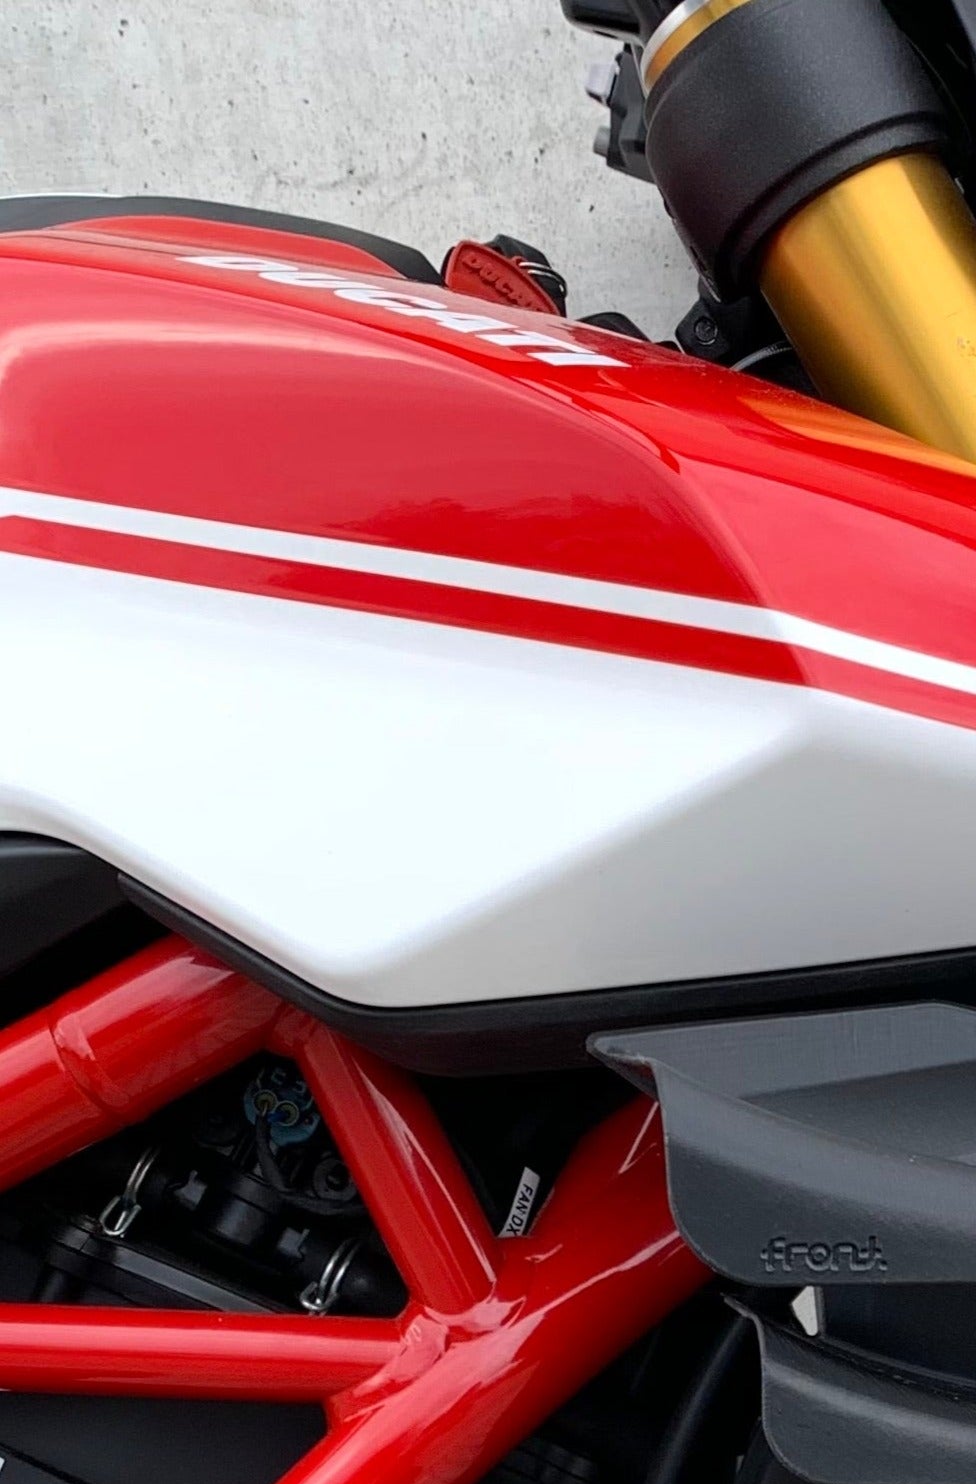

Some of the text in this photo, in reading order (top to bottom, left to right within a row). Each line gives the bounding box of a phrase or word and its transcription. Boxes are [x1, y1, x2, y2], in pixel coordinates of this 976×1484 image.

[174, 255, 633, 367] DUCATI
[506, 1183, 535, 1237] FAN DX
[760, 1235, 888, 1272] front
